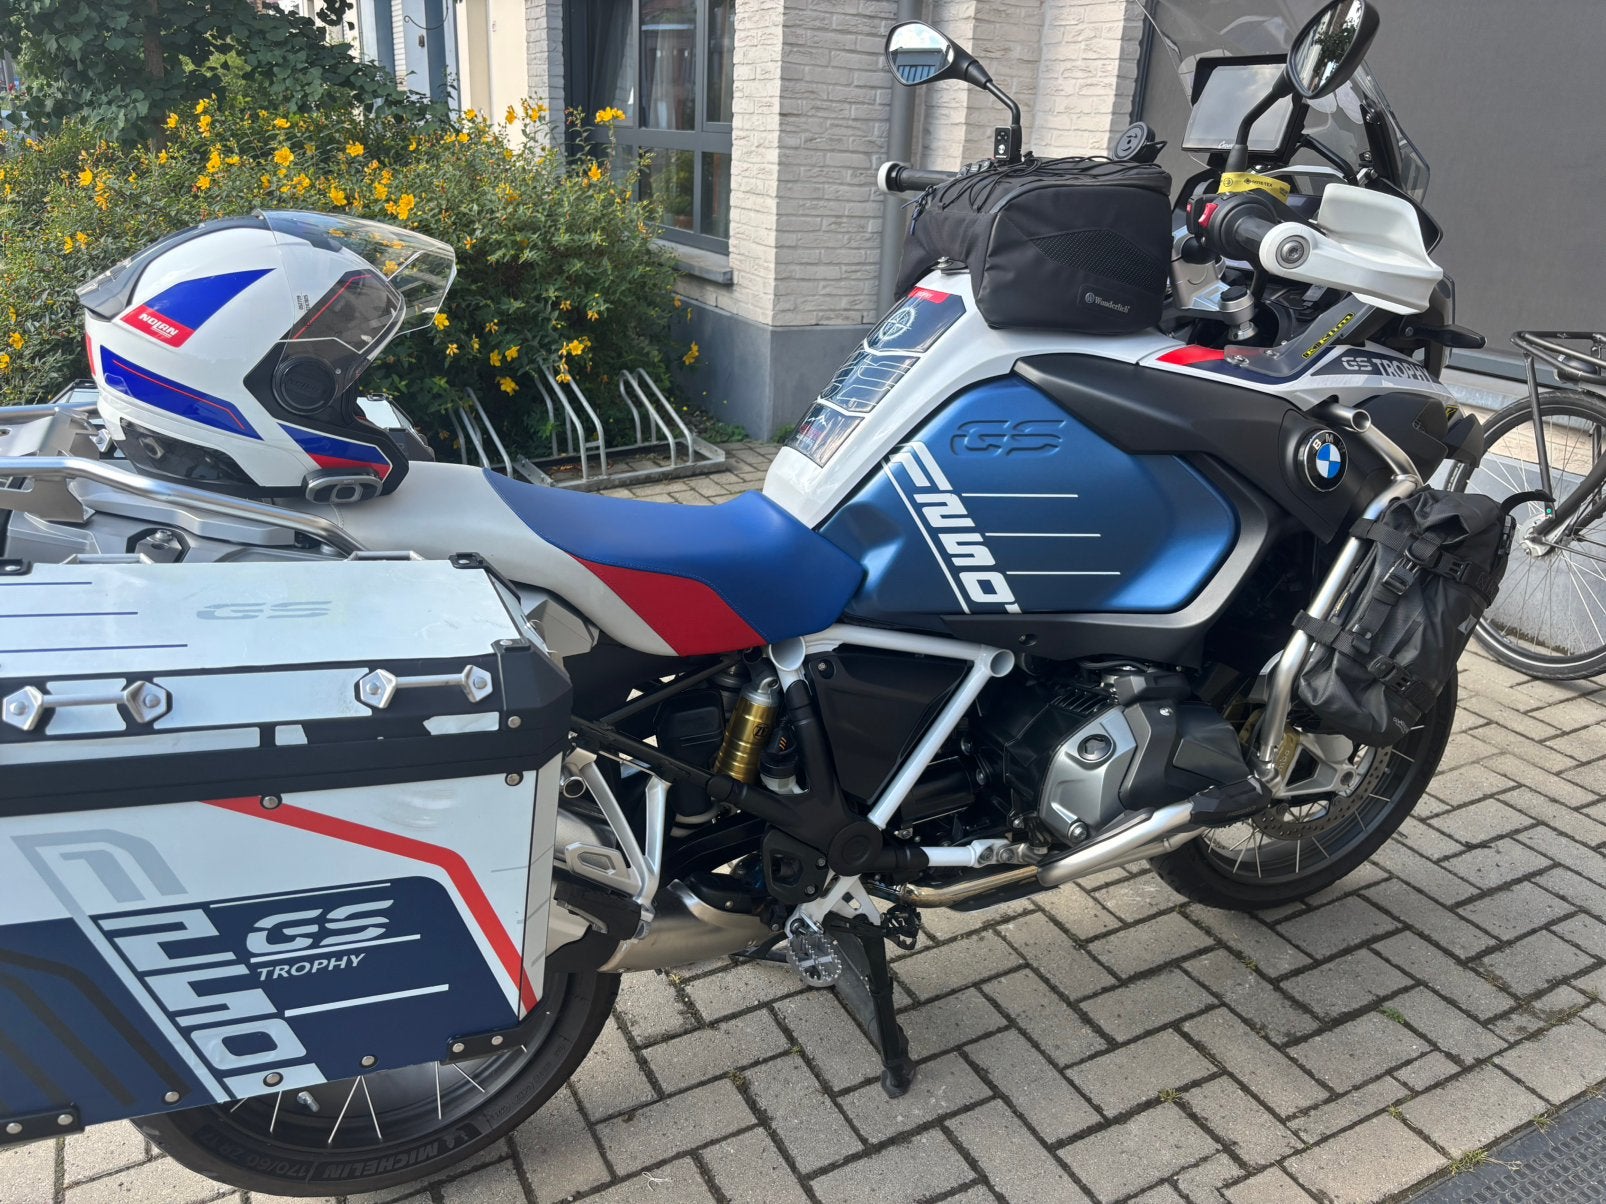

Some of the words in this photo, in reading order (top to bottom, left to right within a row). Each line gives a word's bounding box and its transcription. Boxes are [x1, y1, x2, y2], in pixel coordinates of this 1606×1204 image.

[1095, 296, 1129, 313] Wunderlich
[138, 313, 179, 336] NOLAN
[1341, 356, 1373, 371] GS
[1371, 358, 1432, 383] TROPHY
[950, 419, 1067, 457] GS
[196, 601, 333, 620] GS
[246, 900, 394, 954] GS
[258, 953, 366, 981] TROPHY
[324, 1142, 438, 1178] MICHELIN
